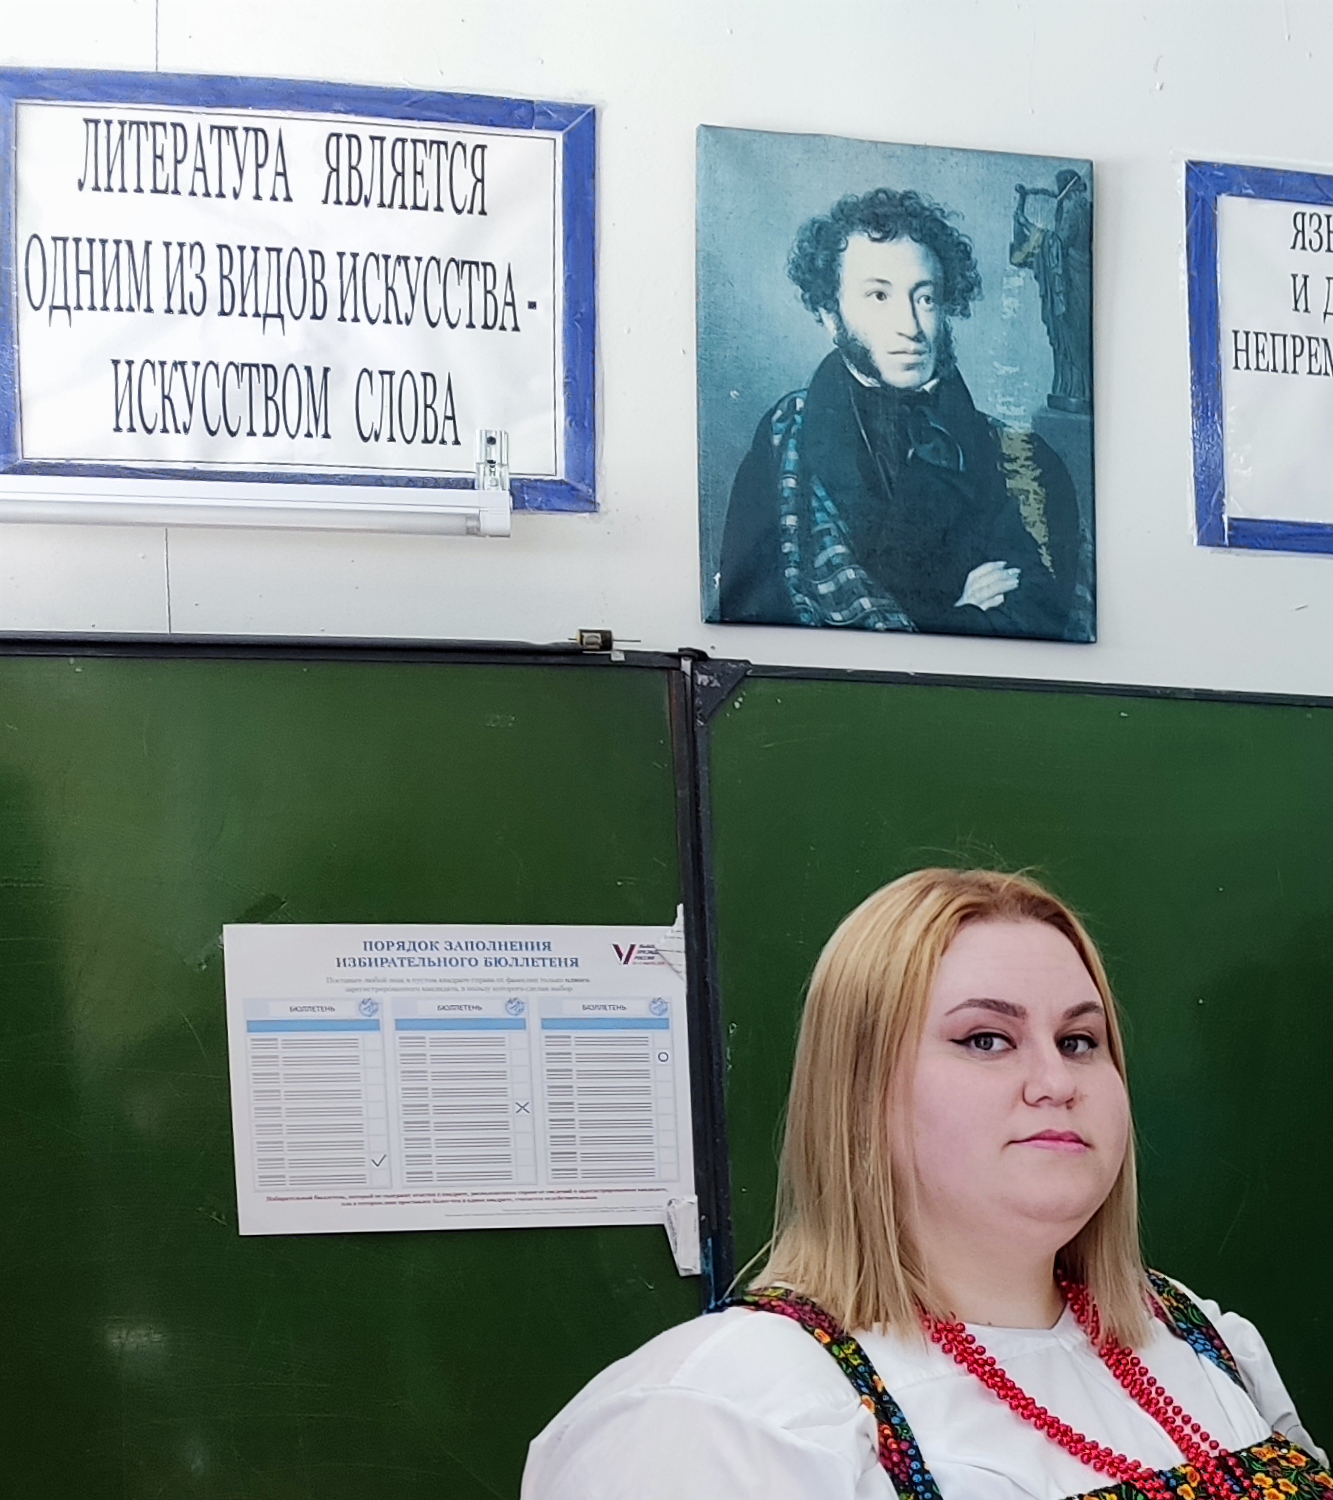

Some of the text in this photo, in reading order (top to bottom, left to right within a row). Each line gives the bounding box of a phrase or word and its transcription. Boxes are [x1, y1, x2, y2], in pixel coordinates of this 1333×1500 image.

[78, 118, 489, 217] ЛИТЕРАТУРА ЯВЛЯЕТСЯ
[24, 234, 153, 328] ОДНИМ
[162, 240, 205, 316] ИЗ
[217, 244, 327, 335] ВИДОВ
[337, 251, 521, 332] ИСКУССТВА
[1291, 274, 1311, 314] И
[110, 359, 461, 446] ИСКУССТВОМ СЛОВА
[336, 956, 579, 969] ИЗБИРАТЕЛЬНОГО БЮЛЛЕТЕНЯ
[362, 940, 552, 953] ПОРЯДОК ЗАПОЛНЕНИЯ
